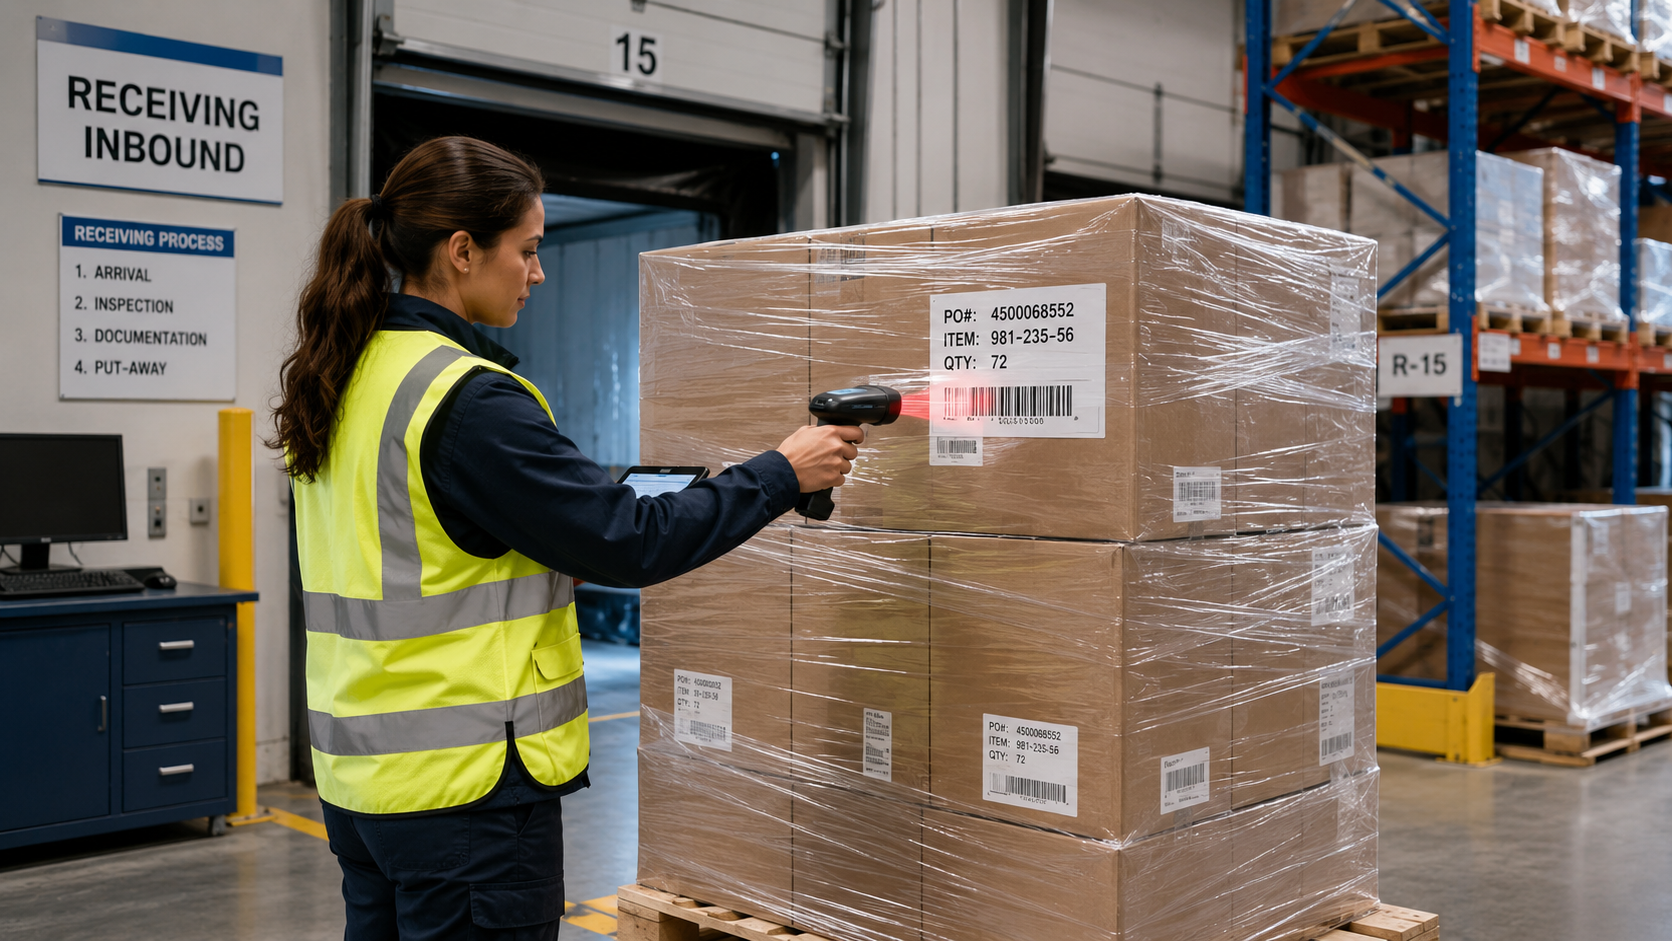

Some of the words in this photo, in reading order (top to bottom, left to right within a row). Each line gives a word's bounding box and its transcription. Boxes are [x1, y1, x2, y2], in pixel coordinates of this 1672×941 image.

[616, 33, 657, 75] 15
[68, 75, 259, 131] RECEIVING
[85, 126, 244, 173] INBOUND
[74, 225, 154, 246] RECEIVING
[159, 231, 224, 252] PROCESS
[75, 264, 87, 279] 1.
[94, 265, 152, 282] ARRIVAL
[75, 296, 87, 310] 2.
[94, 297, 174, 313] INSPECTION
[944, 309, 977, 324] PO#:
[991, 302, 1075, 321] 4500068552
[75, 328, 87, 342] 3.
[94, 328, 207, 346] DOCUMENTATION
[944, 332, 980, 347] ITEM:
[991, 327, 1074, 345] 981-235-56
[75, 360, 87, 374] 4.
[94, 360, 167, 375] PUT-AWAY
[944, 355, 977, 370] QTY:
[991, 354, 1007, 369] 72
[1392, 353, 1447, 376] R-15
[988, 736, 1011, 748] ITEM:
[988, 750, 1009, 761] QTY:
[1016, 754, 1026, 764] 72
